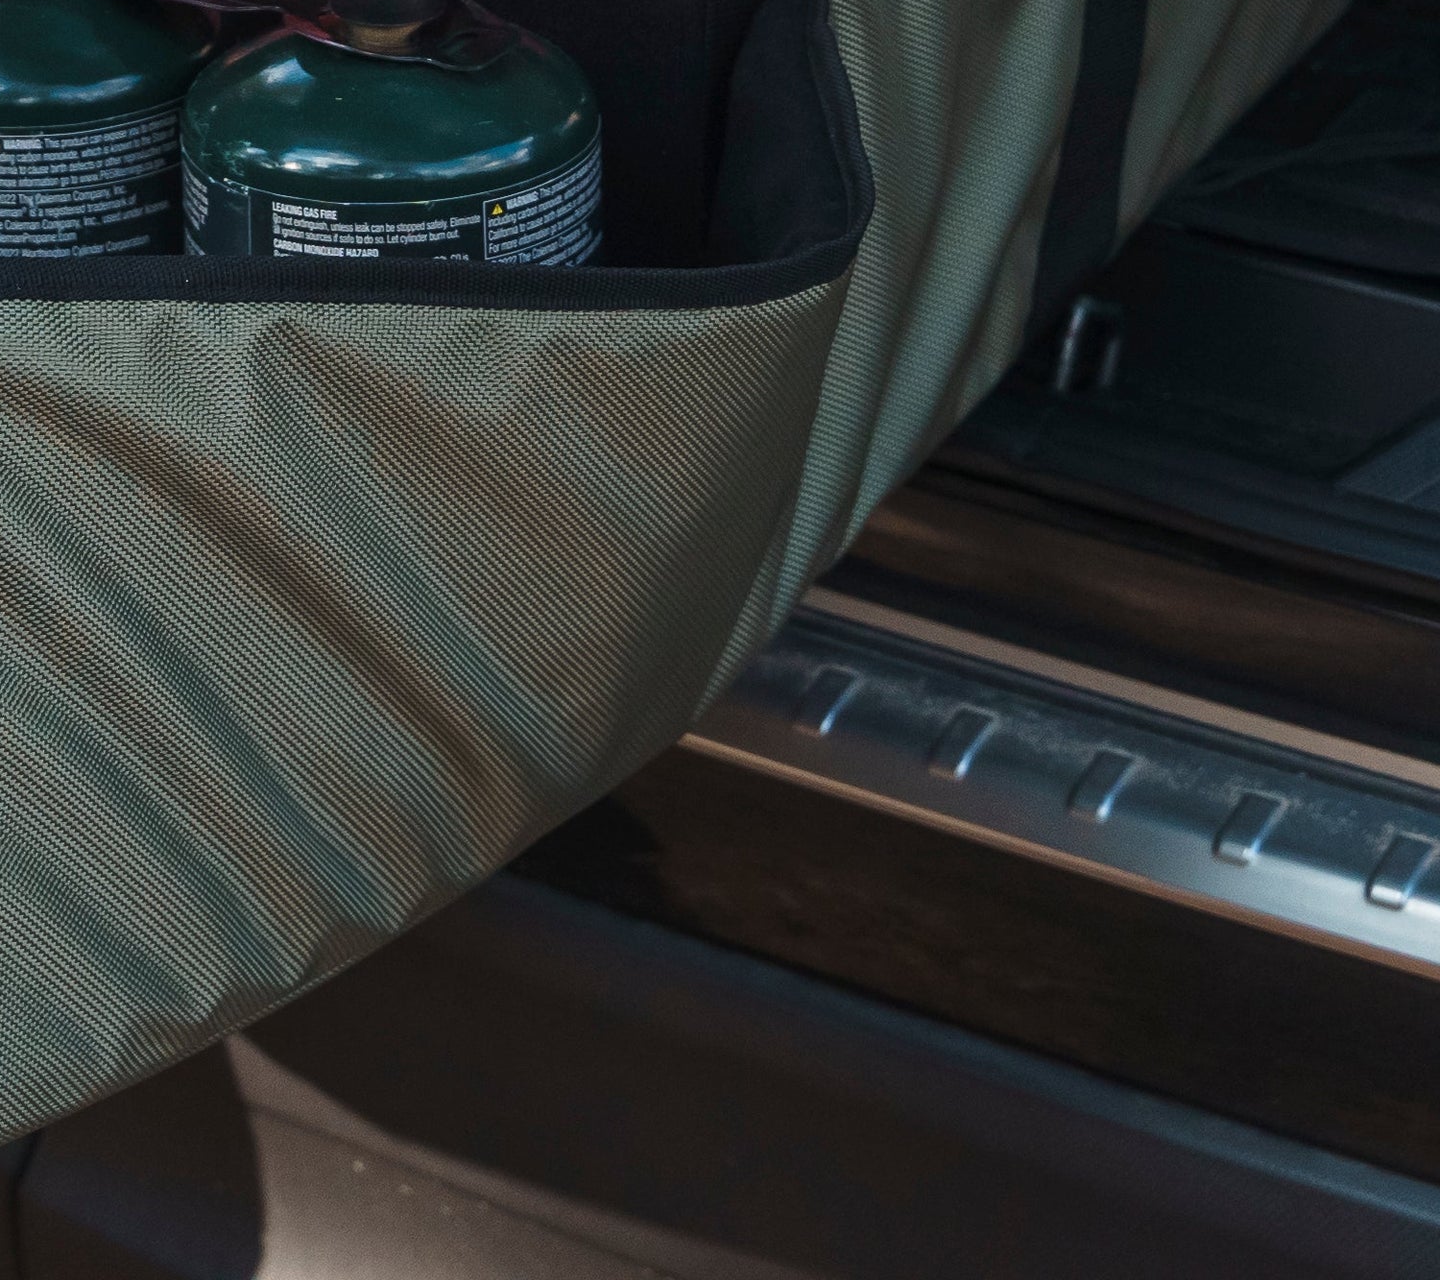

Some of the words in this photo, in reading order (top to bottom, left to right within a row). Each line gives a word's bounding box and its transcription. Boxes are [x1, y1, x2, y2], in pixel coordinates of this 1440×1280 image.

[272, 201, 302, 216] LEAKING
[303, 207, 319, 218] GAS
[320, 209, 337, 220] FIRE
[282, 216, 293, 225] not
[331, 223, 353, 232] unless
[355, 222, 370, 232] leak
[371, 224, 384, 232] can
[386, 223, 395, 232] be
[396, 221, 425, 232] stopped
[450, 215, 480, 227] Eliminate
[356, 235, 362, 243] to
[364, 235, 374, 244] do
[387, 235, 399, 243] Let
[400, 233, 427, 244] cylinder
[429, 231, 445, 240] burn
[274, 238, 303, 252] CARBON
[304, 244, 344, 257] MONOXIDE
